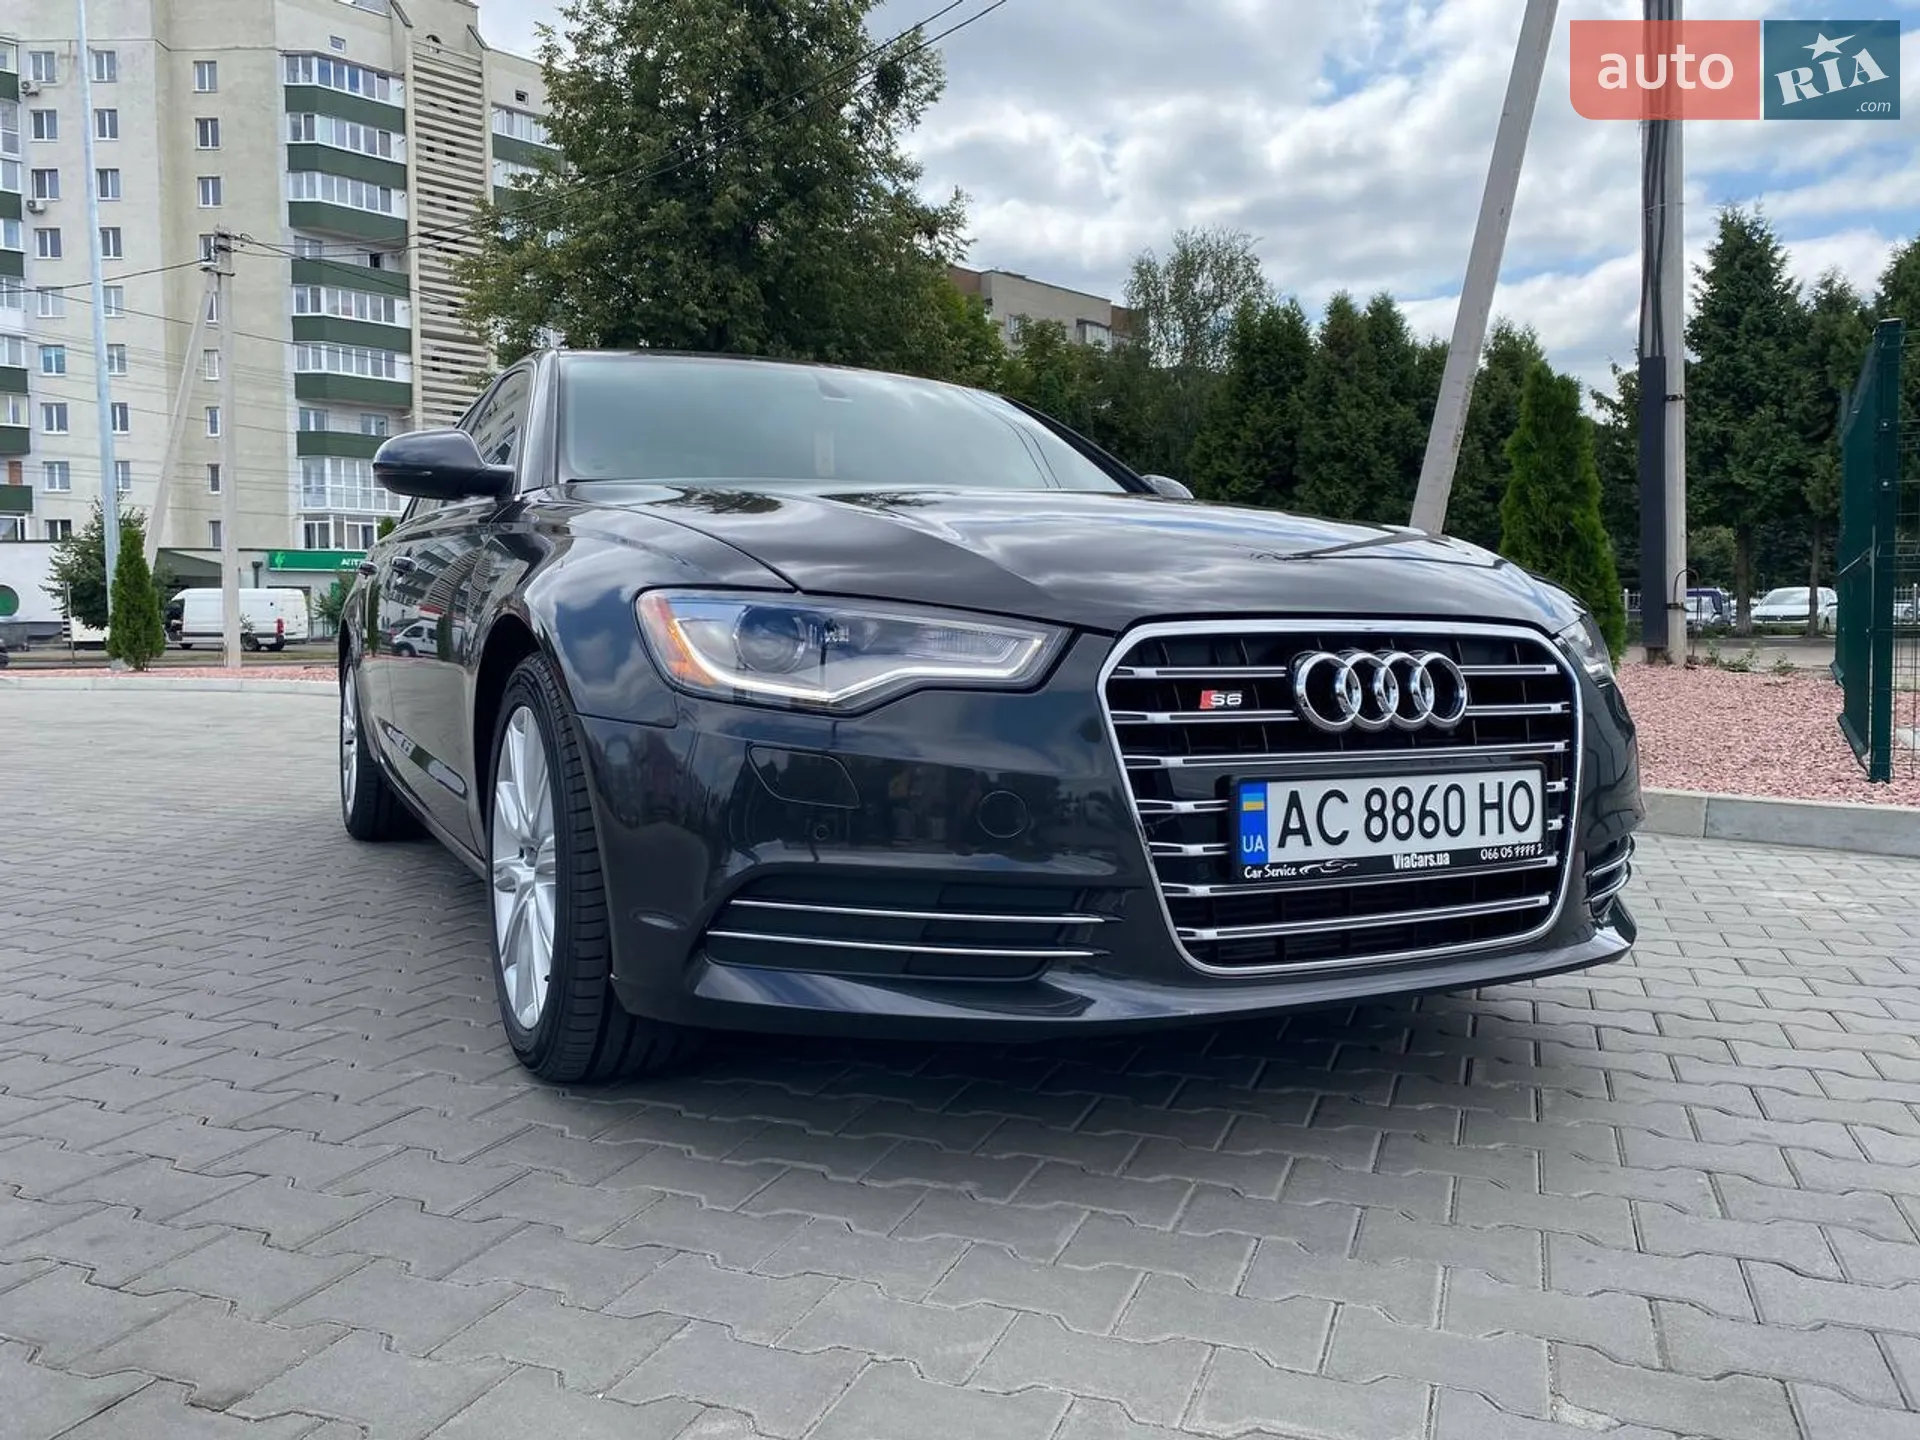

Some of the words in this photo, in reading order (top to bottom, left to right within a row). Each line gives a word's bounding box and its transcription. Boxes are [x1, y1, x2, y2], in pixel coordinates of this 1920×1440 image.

[1209, 693, 1242, 706] S6
[1277, 788, 1349, 848] AC
[1364, 783, 1466, 843] 8860
[1479, 779, 1535, 836] HO
[1243, 836, 1265, 853] UA
[1393, 852, 1450, 869] ViaCars.ua
[1481, 848, 1499, 860] 066
[1244, 866, 1263, 878] Car
[1264, 864, 1297, 877] Service
